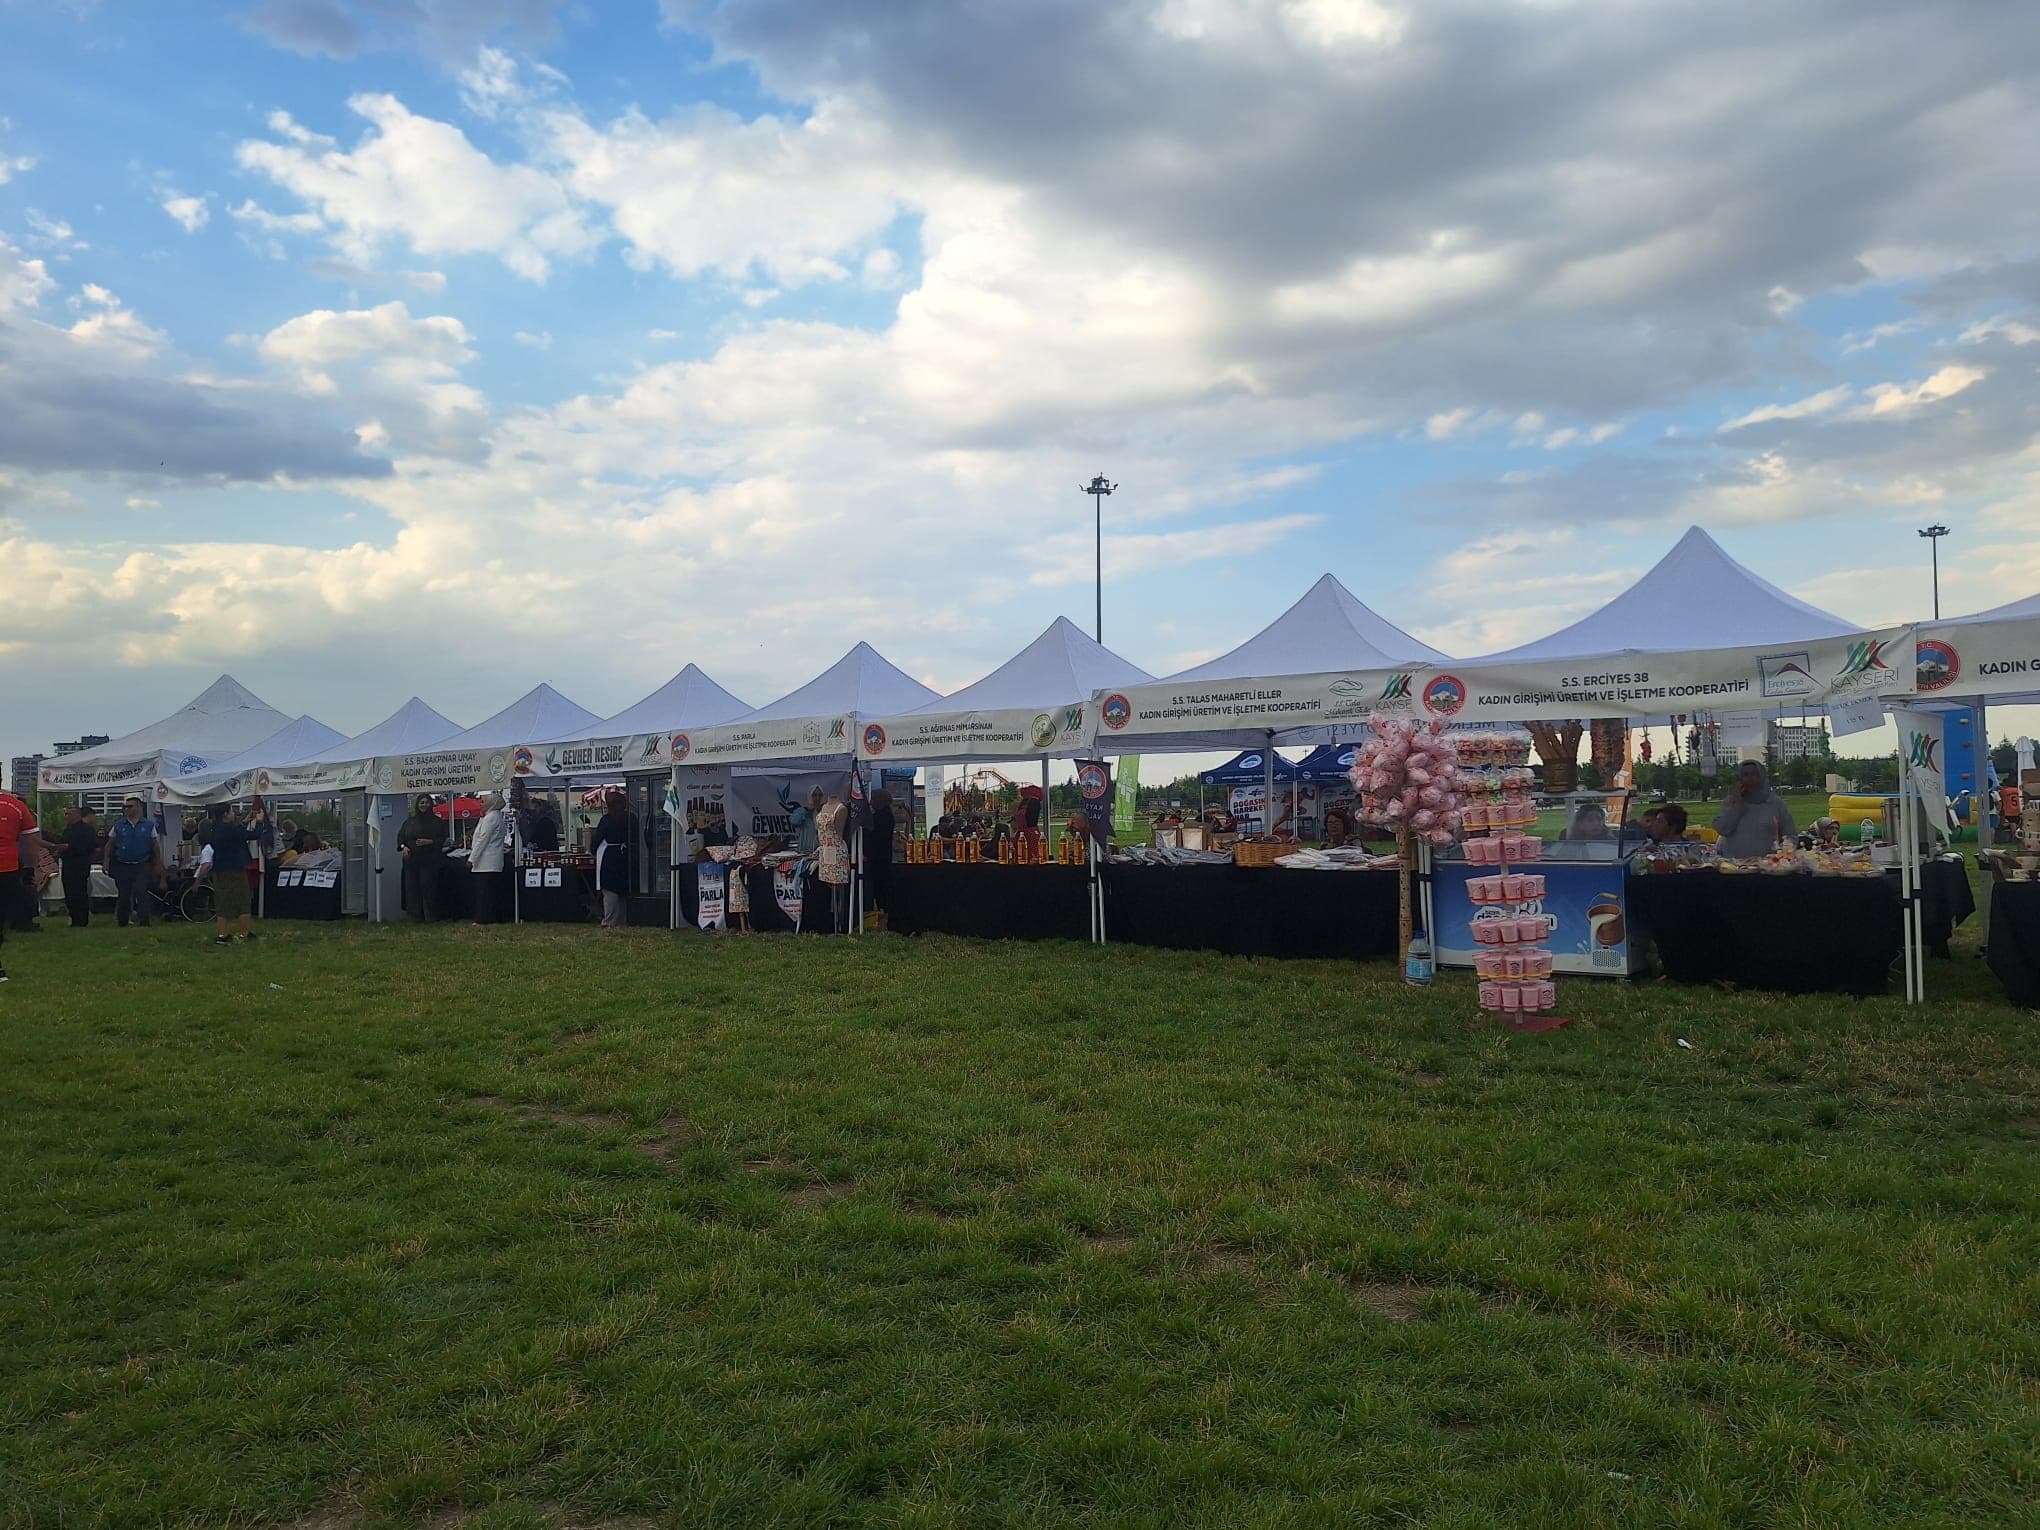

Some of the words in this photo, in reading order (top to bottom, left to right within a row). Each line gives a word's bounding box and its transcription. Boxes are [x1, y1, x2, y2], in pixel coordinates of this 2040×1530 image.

[1979, 660, 2026, 675] KADIN
[1561, 677, 1581, 687] S.S.
[1583, 672, 1630, 686] ERCİYES
[1634, 672, 1649, 683] 38
[1172, 696, 1185, 705] S.S.
[1186, 694, 1210, 704] TALAS
[1211, 689, 1256, 702] MAHARETLİ
[1257, 690, 1282, 700] ELLER
[1478, 695, 1511, 705] KADIN
[1513, 691, 1555, 706] GİRİŞİMİ
[1557, 690, 1597, 702] ÜRETİM
[1600, 690, 1615, 701] VE
[1617, 687, 1666, 702] İŞLETME
[1668, 678, 1749, 697] KOOPERATİFİ
[1139, 710, 1161, 720] KADIN
[1162, 707, 1192, 720] GİRİŞİMİ
[1193, 705, 1221, 717] ÜRETİM
[1222, 706, 1233, 715] VE
[1233, 703, 1266, 716] İŞLETME
[1267, 698, 1321, 713] KOOPERATİFİ
[892, 737, 909, 746] KADIN
[953, 735, 961, 743] VE
[562, 747, 592, 766] GEVHER
[594, 744, 623, 764] NESİBE
[700, 888, 724, 902] PARLA
